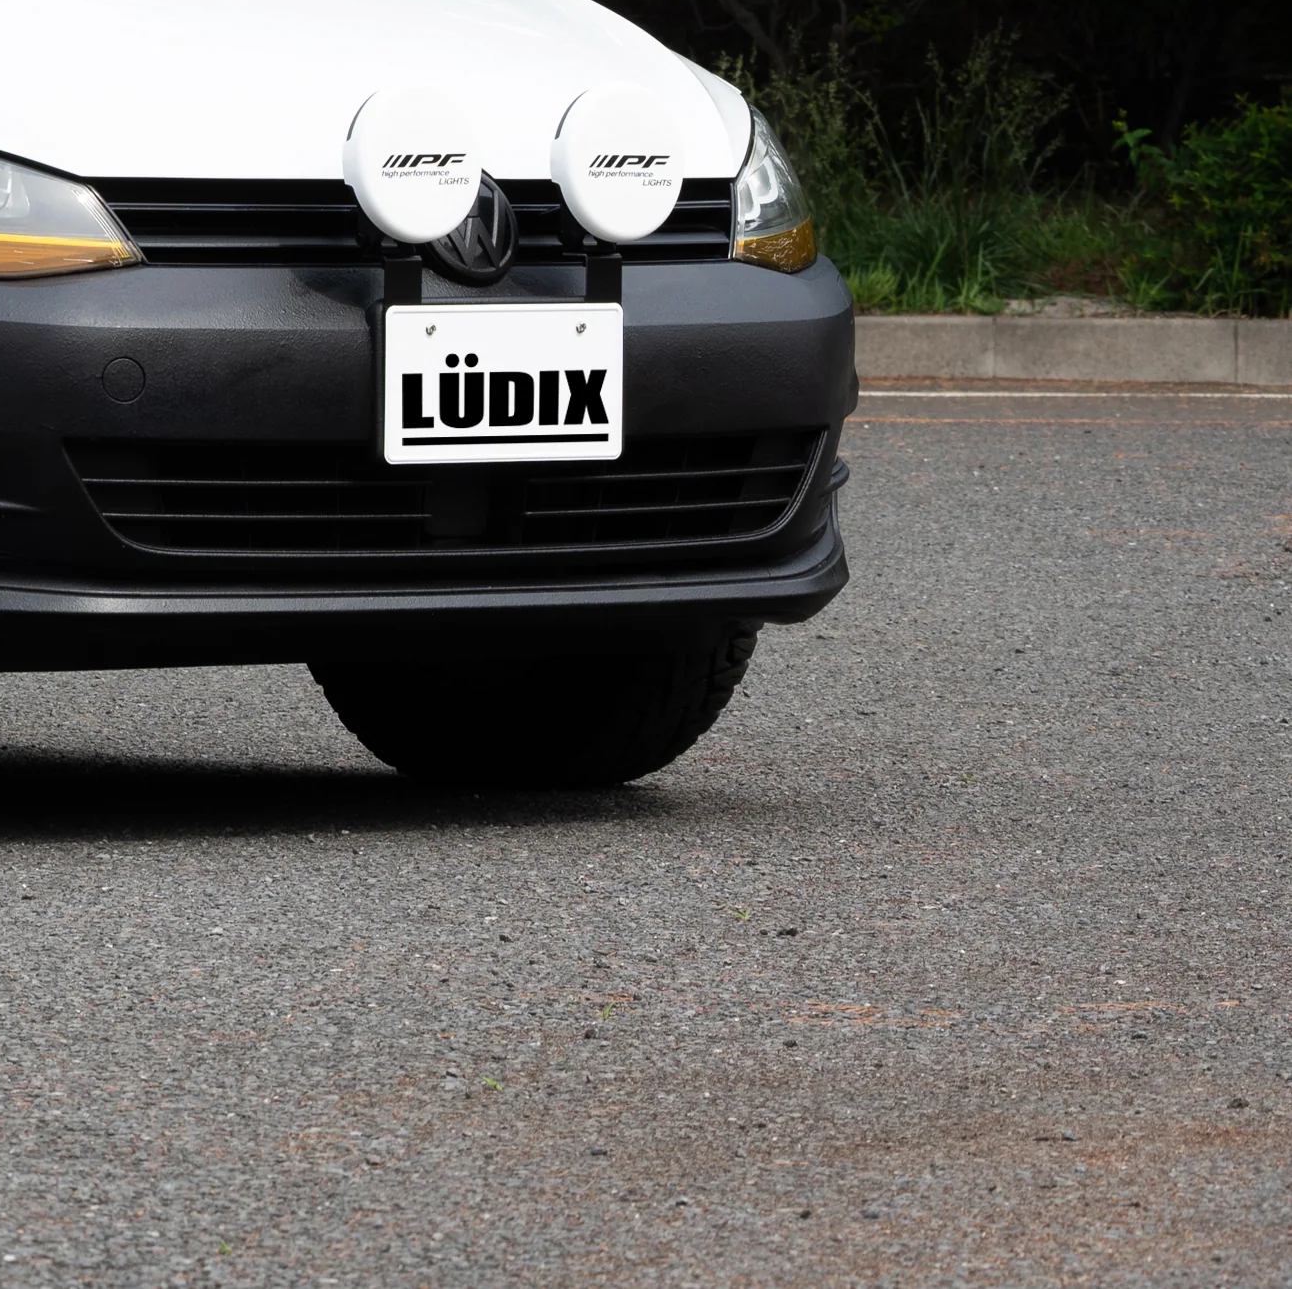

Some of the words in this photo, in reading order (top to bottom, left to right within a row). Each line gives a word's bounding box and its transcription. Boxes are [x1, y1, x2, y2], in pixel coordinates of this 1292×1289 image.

[381, 169, 399, 179] high
[399, 169, 450, 178] performance
[588, 169, 605, 179] high
[605, 169, 654, 178] performance
[438, 177, 470, 186] LIGHTS
[642, 179, 672, 187] LIGHTS
[401, 352, 610, 429] LÜDIX
